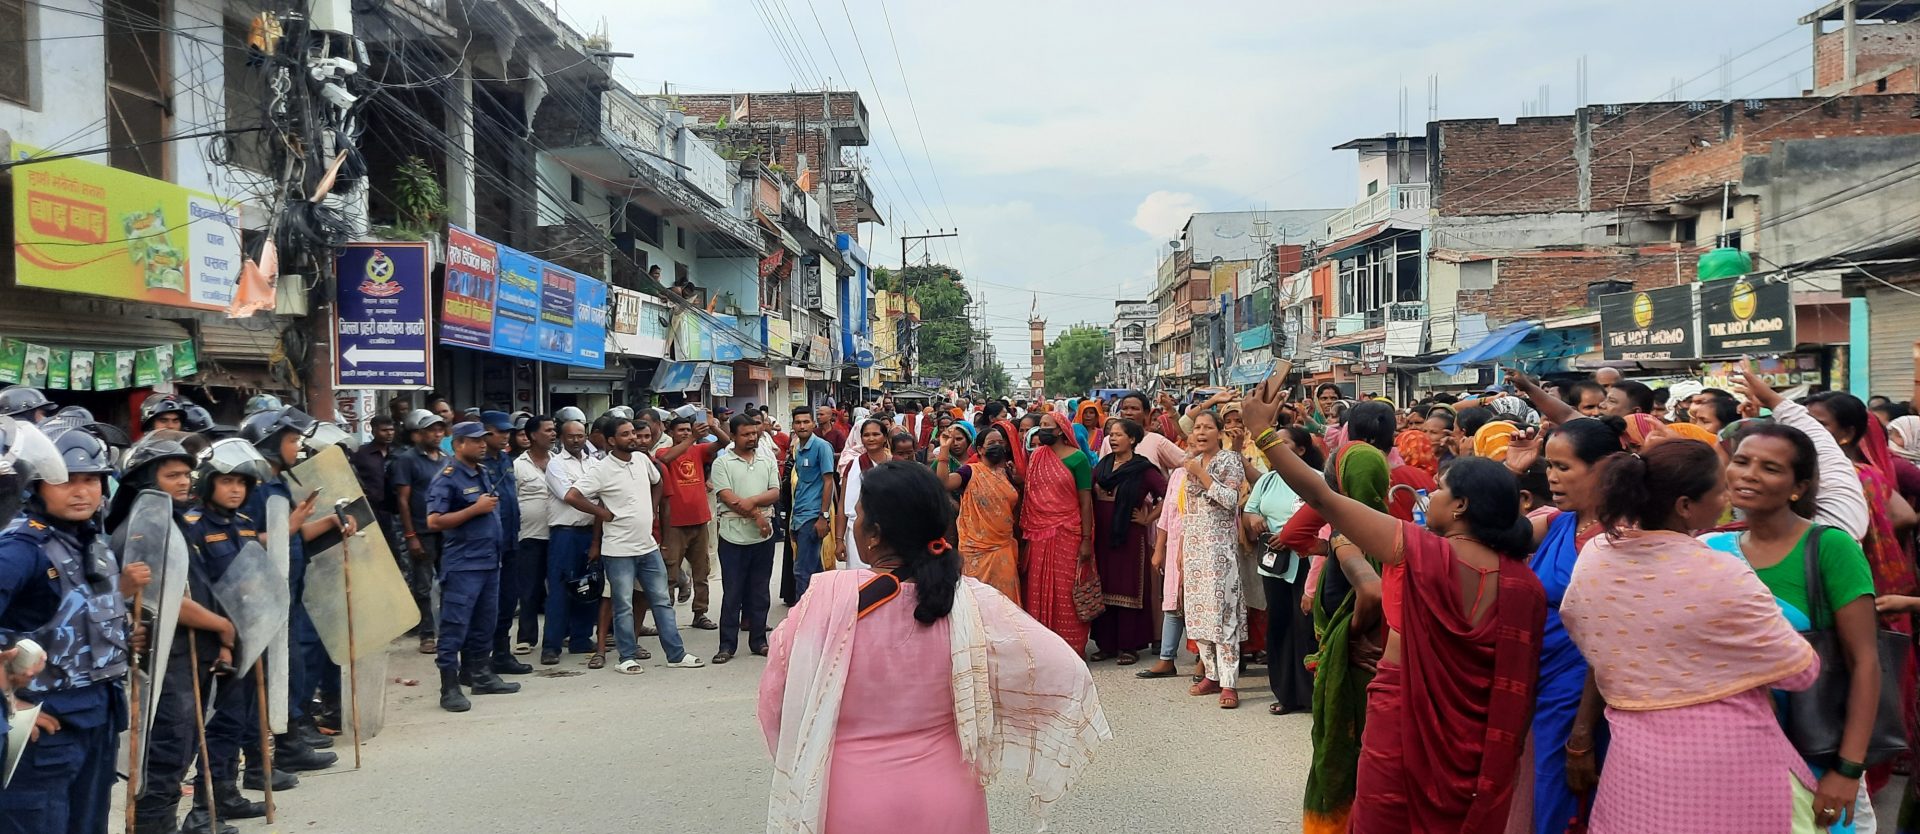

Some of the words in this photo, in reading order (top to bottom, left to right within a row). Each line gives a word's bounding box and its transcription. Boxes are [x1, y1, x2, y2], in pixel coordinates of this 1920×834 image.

[207, 233, 224, 246] पान
[204, 256, 228, 270] पसल
[338, 317, 359, 335] जिल्ला
[360, 317, 376, 336] प्रहरी
[377, 318, 404, 335] कार्यालय
[405, 318, 425, 336] सप्तरी
[1708, 323, 1726, 336] THE
[1728, 320, 1749, 334] HOT
[1750, 317, 1783, 332] MOMO
[1609, 331, 1626, 346] THE
[1628, 330, 1648, 346] HOT
[1650, 327, 1684, 344] MOMO
